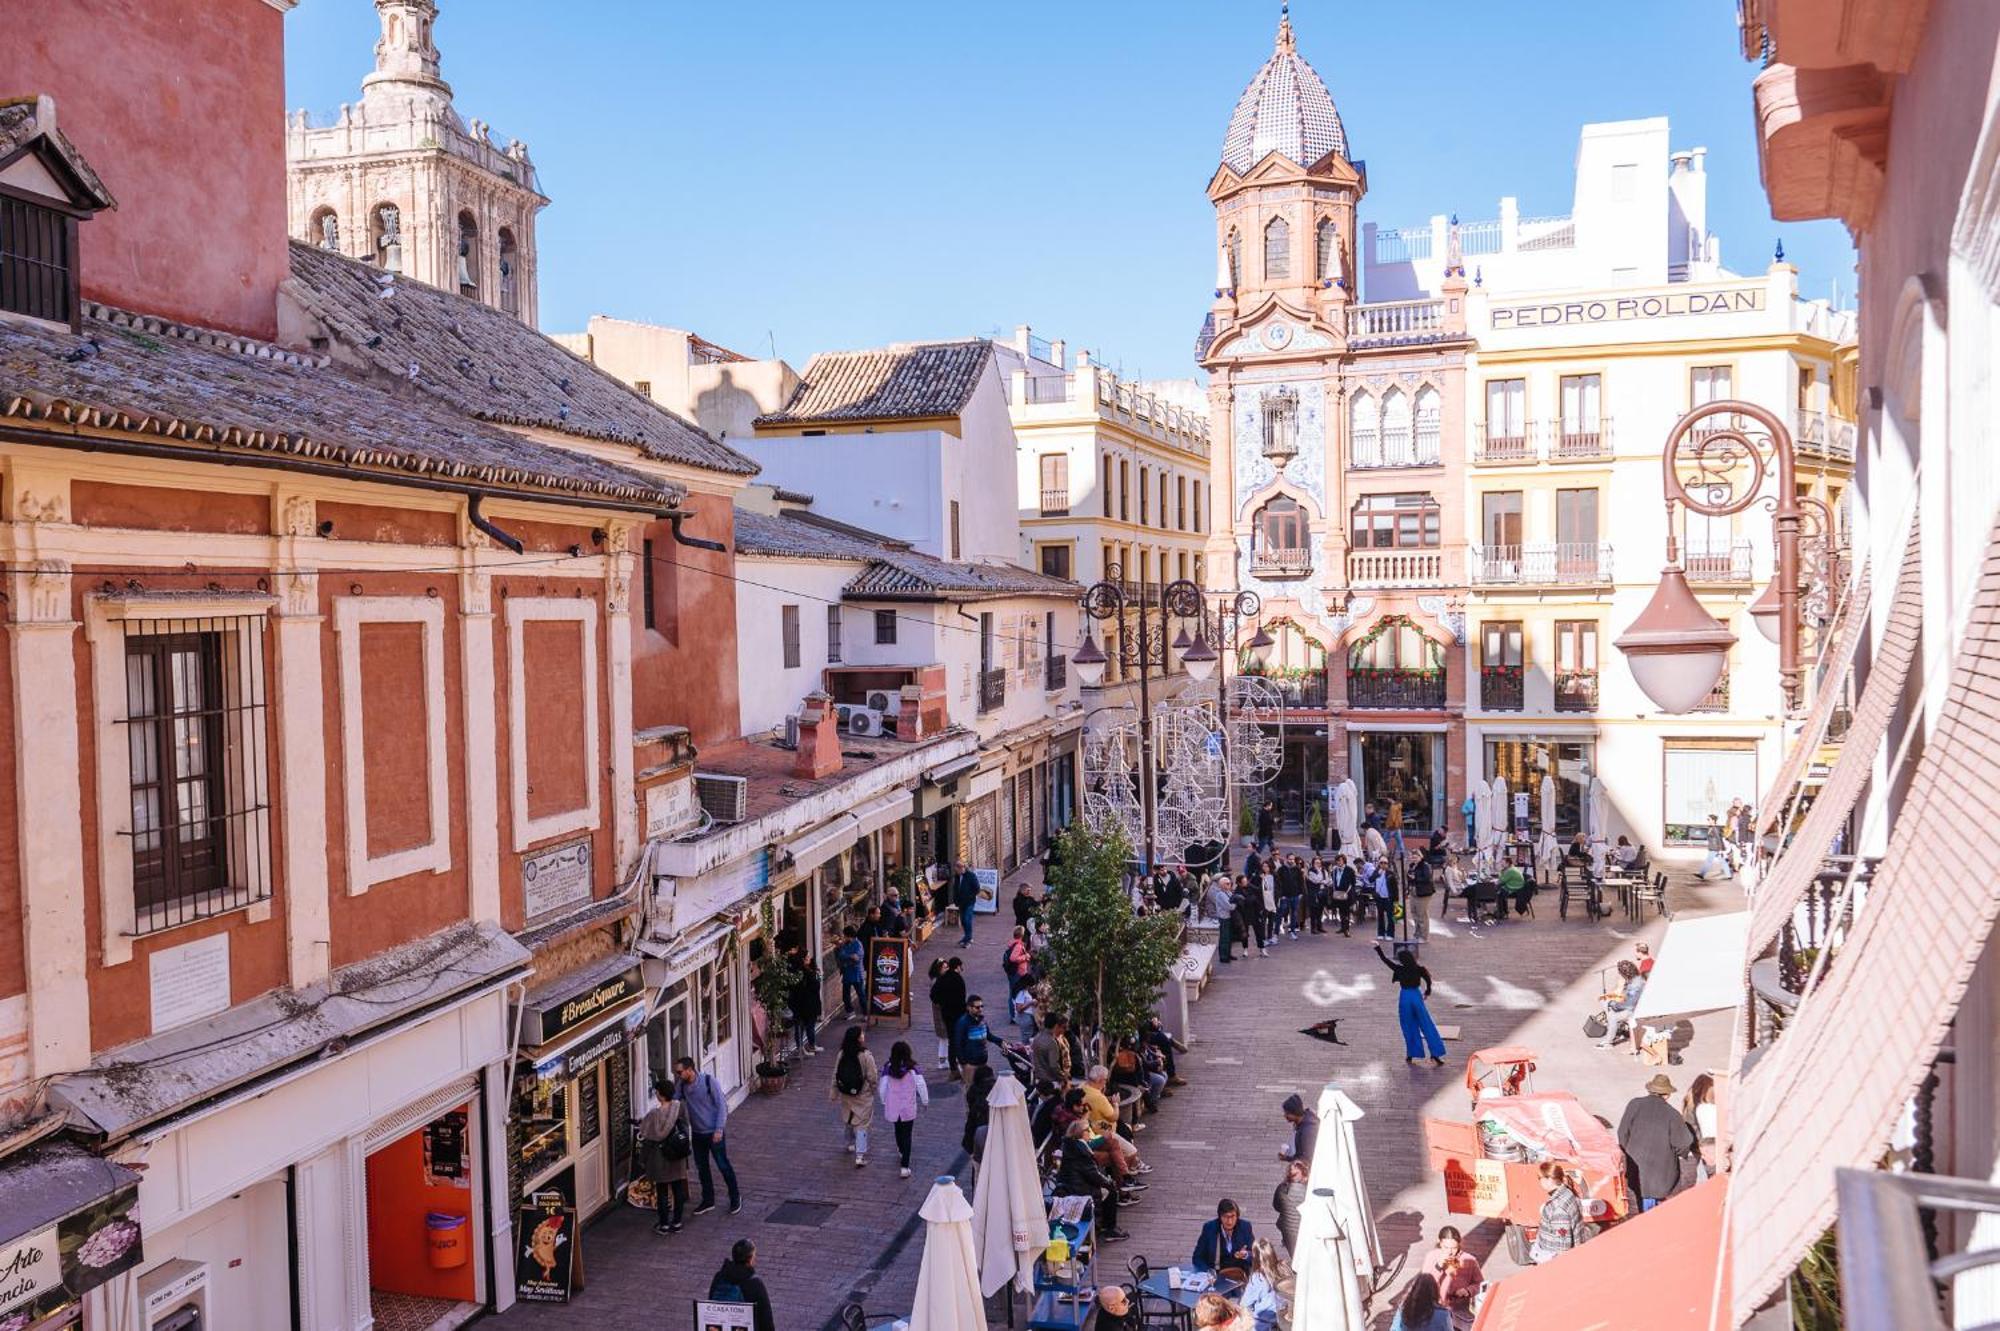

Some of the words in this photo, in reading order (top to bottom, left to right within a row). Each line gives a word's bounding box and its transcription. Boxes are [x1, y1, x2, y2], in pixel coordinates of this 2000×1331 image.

[1492, 303, 1606, 328] PEDRO
[1617, 291, 1756, 319] ROLDAN
[560, 980, 625, 1025] #BreadSquare
[0, 1247, 43, 1283] Arte
[0, 1278, 37, 1305] ncia
